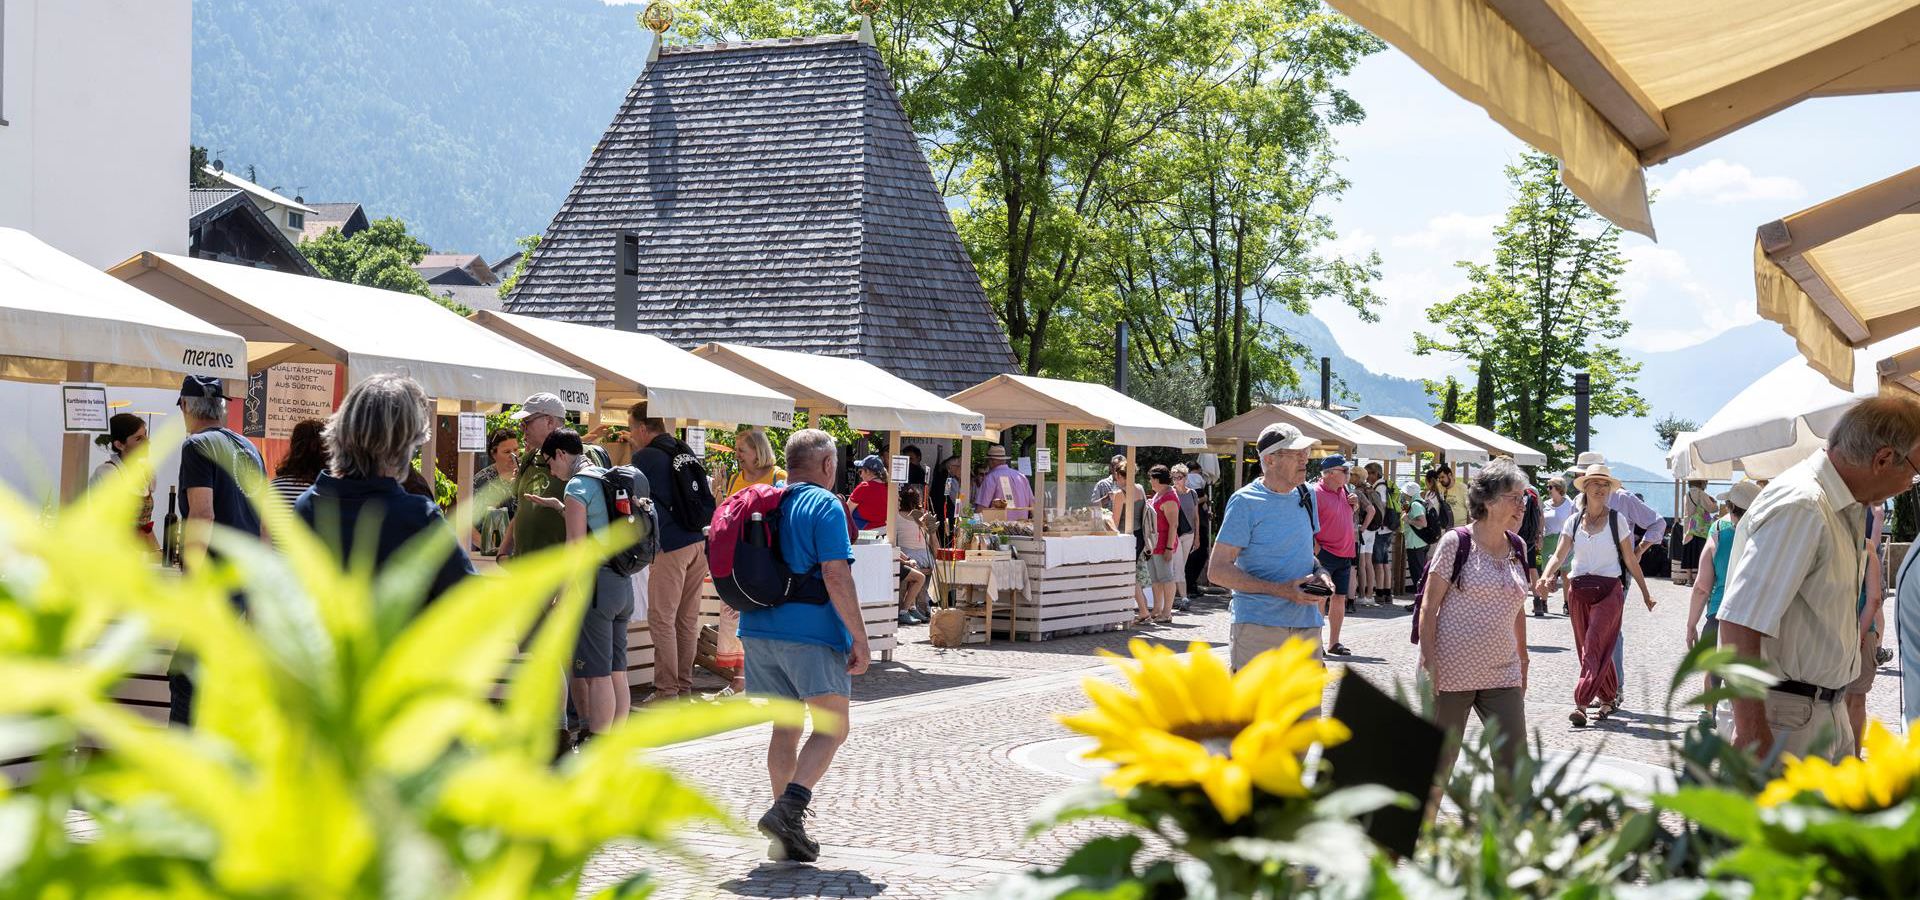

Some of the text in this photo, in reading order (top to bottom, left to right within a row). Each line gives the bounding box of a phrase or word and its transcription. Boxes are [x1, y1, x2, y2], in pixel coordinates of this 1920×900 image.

[183, 349, 234, 368] merano
[271, 365, 333, 376] QUALITÄTSHONIG
[291, 382, 327, 392] SÜDTIROL
[269, 397, 291, 405] MIELE
[560, 389, 590, 405] merano
[284, 407, 320, 415] IDROMELE
[772, 411, 791, 422] merano
